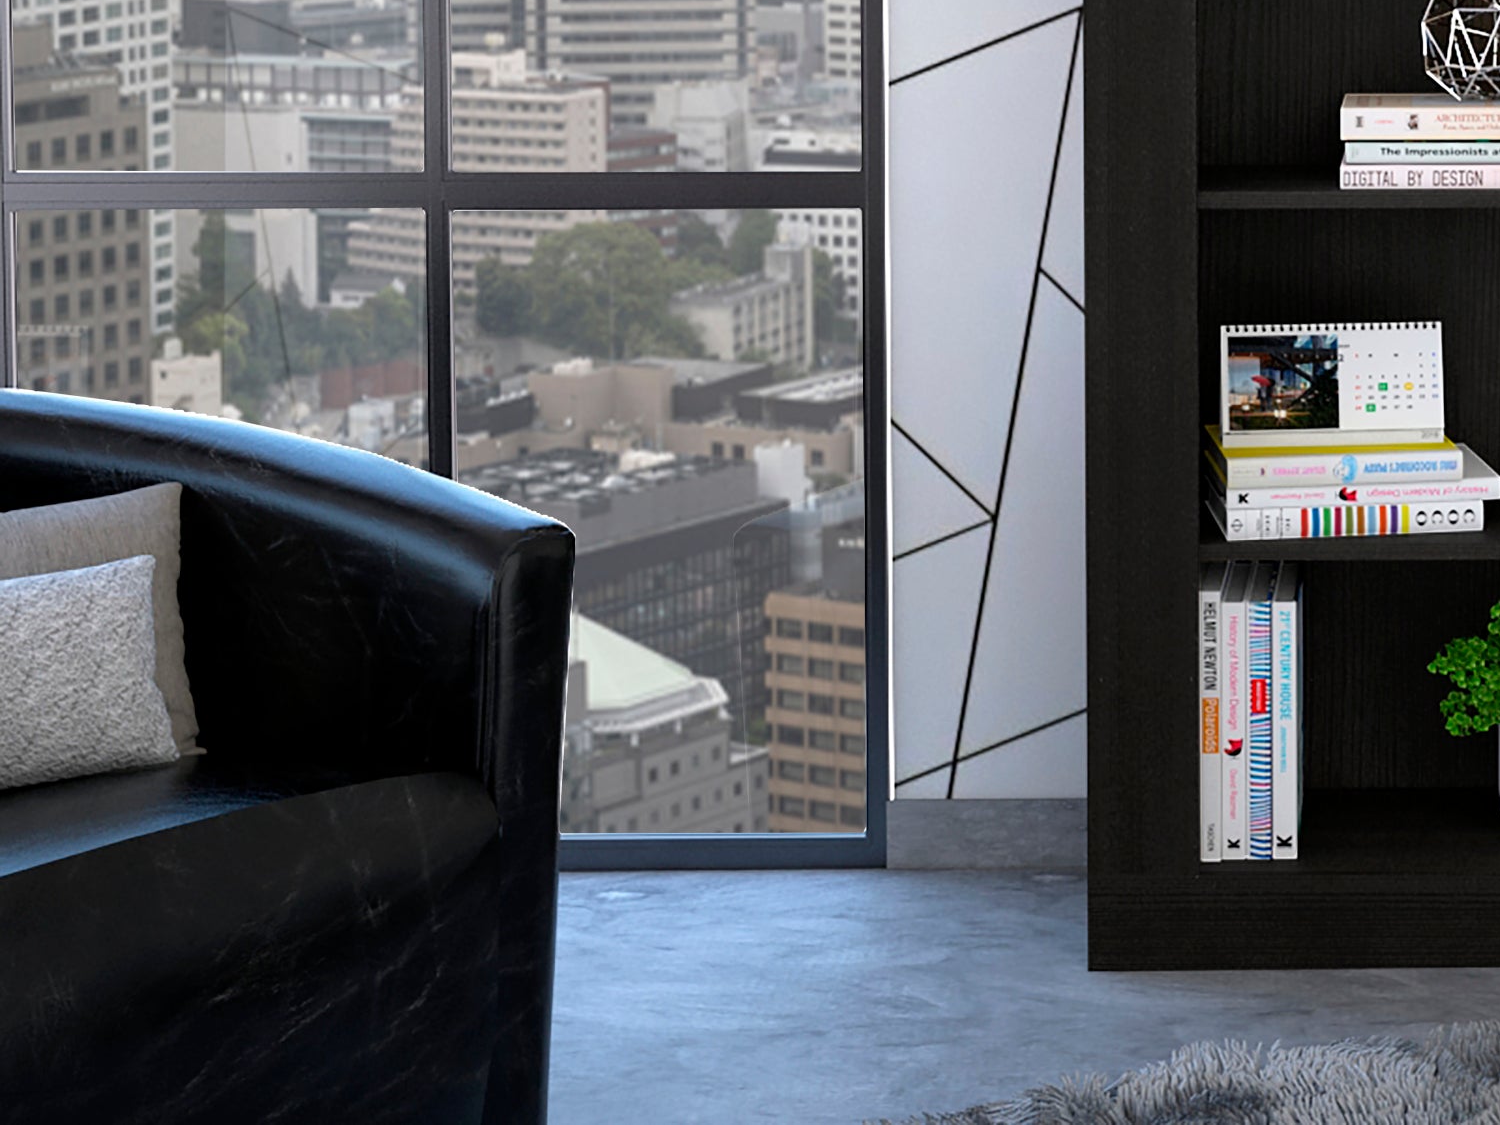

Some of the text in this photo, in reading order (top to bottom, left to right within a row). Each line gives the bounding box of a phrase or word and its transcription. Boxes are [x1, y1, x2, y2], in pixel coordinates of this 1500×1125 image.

[1380, 147, 1401, 156] The
[1405, 147, 1488, 157] Impressionists
[1343, 170, 1483, 187] DIGITAL BY DESIGN
[1366, 485, 1489, 498] History of Modern Design
[1203, 602, 1217, 691] HELMUT NEWTON
[1280, 630, 1291, 680] CENTURY
[1227, 616, 1239, 731] History of Modern Design
[1280, 683, 1292, 721] HOUSE
[1204, 698, 1218, 753] Polaroids
